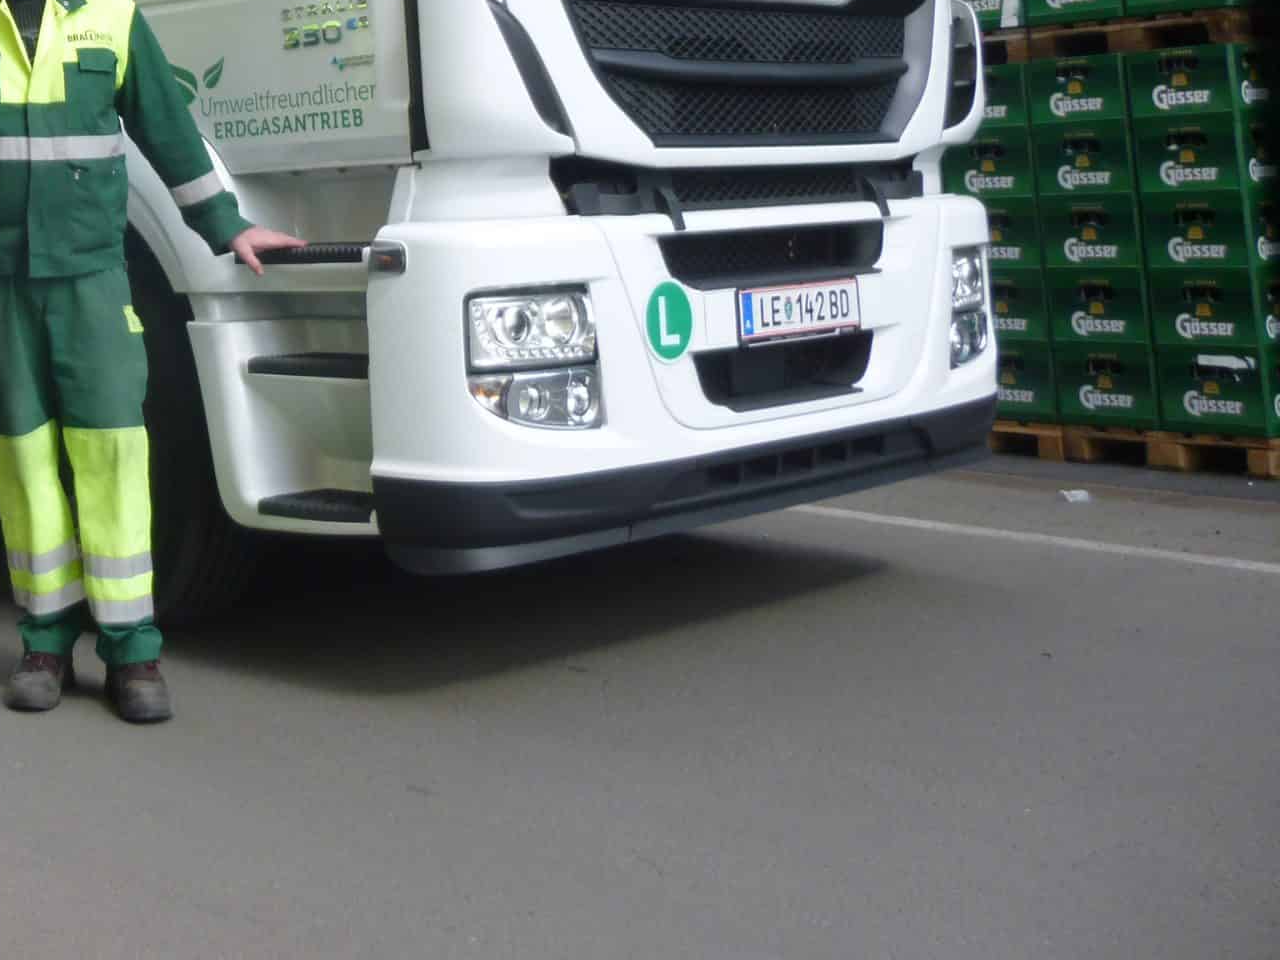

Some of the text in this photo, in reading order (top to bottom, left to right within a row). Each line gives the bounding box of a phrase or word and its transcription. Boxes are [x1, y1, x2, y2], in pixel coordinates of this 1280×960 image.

[200, 81, 377, 118] Umweltfreundlicher
[1050, 92, 1103, 118] Gösser
[1152, 84, 1210, 111] Gösser
[214, 107, 364, 140] ERDGASANTRIEB
[966, 169, 1014, 193] Gösser
[1057, 164, 1111, 191] Gösser
[1160, 160, 1218, 187] Gösser
[1064, 237, 1118, 263] Gösser
[1168, 236, 1226, 264] Gösser
[658, 295, 681, 346] L
[760, 288, 851, 328] LE 142 BD
[1072, 310, 1125, 337] Gösser
[1176, 312, 1234, 340] Gösser
[1080, 384, 1133, 410] Gösser
[1184, 389, 1242, 417] Gösser
